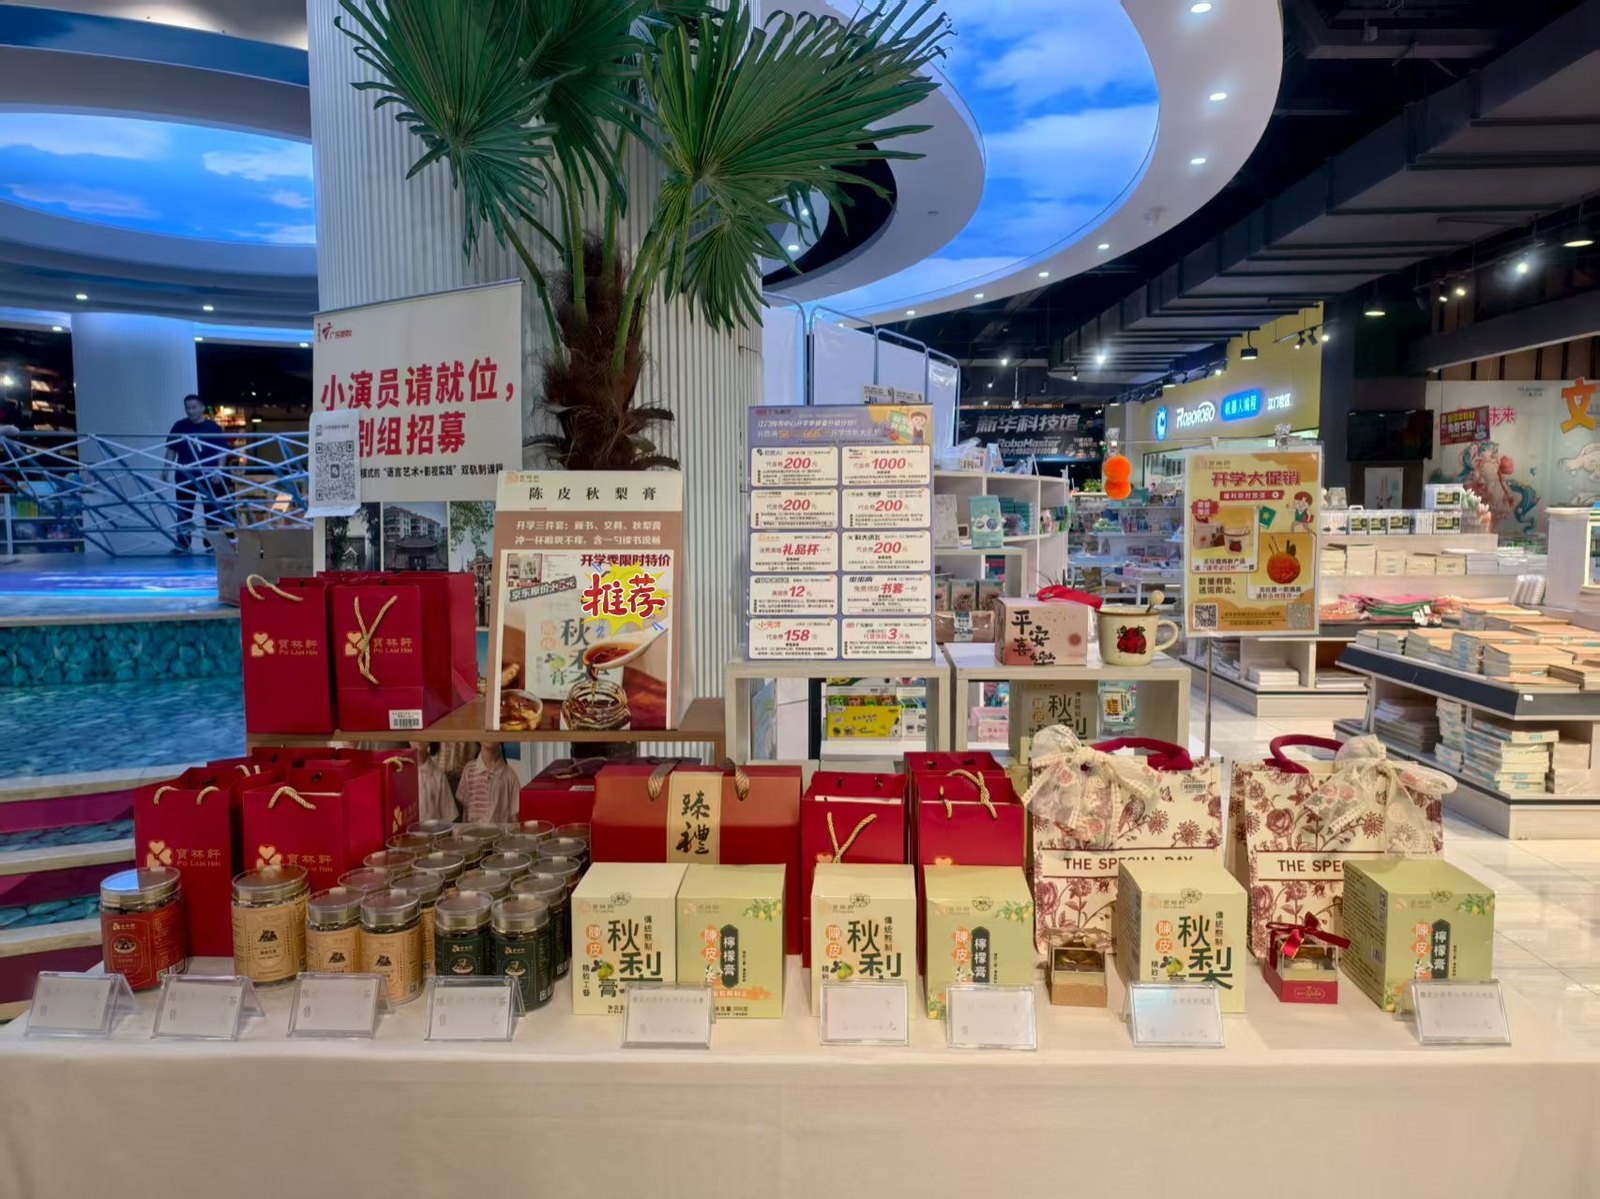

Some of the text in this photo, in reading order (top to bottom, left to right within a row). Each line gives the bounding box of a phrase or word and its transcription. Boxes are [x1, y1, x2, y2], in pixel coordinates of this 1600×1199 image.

[1225, 395, 1257, 416] 机器人编程
[976, 413, 1081, 433] 新华科技馆
[784, 457, 811, 469] 200
[872, 457, 906, 470] 1000
[1212, 471, 1301, 487] 开学大促销
[529, 486, 656, 501] 陈皮秋梨膏
[783, 499, 811, 511] 200
[875, 500, 903, 512] 200
[782, 543, 819, 556] 礼品杯
[873, 541, 902, 554] 200
[789, 585, 805, 597] 12
[881, 583, 904, 594] 书套
[784, 629, 810, 641] 158
[888, 628, 897, 640] 3
[1063, 857, 1092, 870] THE
[1277, 859, 1345, 872] THE SPE
